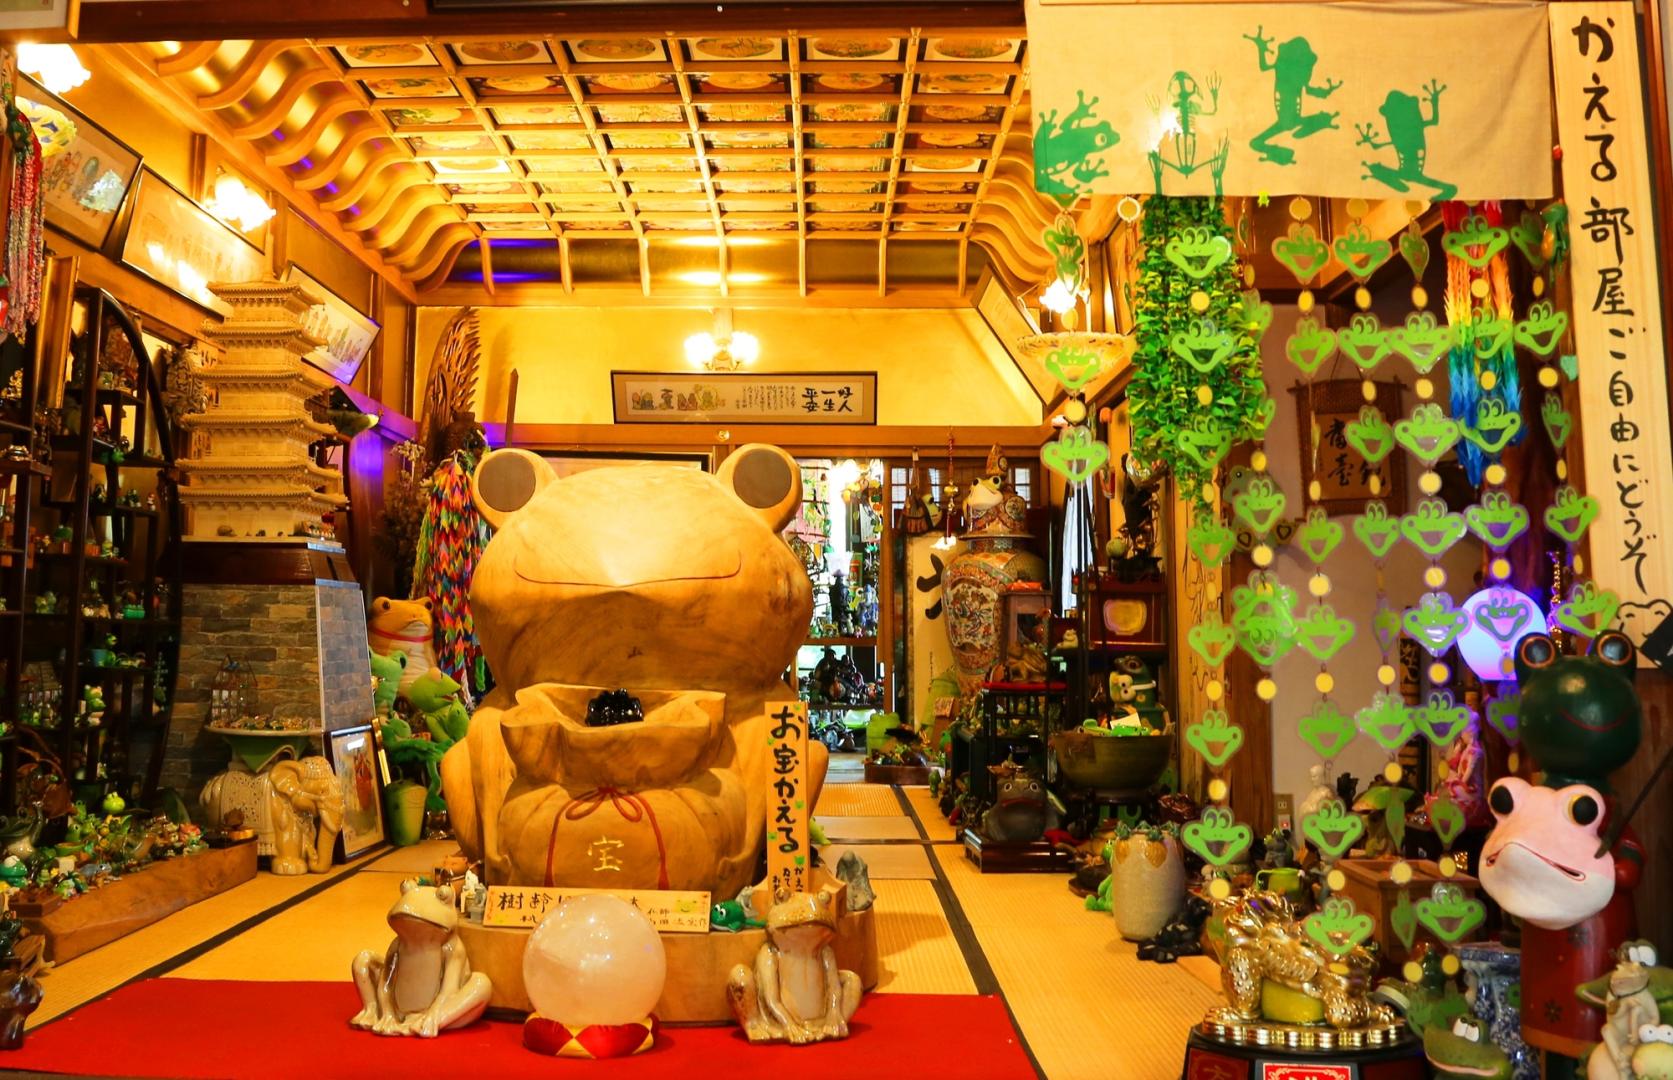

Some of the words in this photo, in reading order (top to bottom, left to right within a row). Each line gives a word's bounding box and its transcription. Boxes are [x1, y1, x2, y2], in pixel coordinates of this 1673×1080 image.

[1572, 15, 1656, 594] かえる部屋ご自由にどうぞ
[588, 835, 624, 871] 宝
[771, 705, 805, 853] お宝かえる
